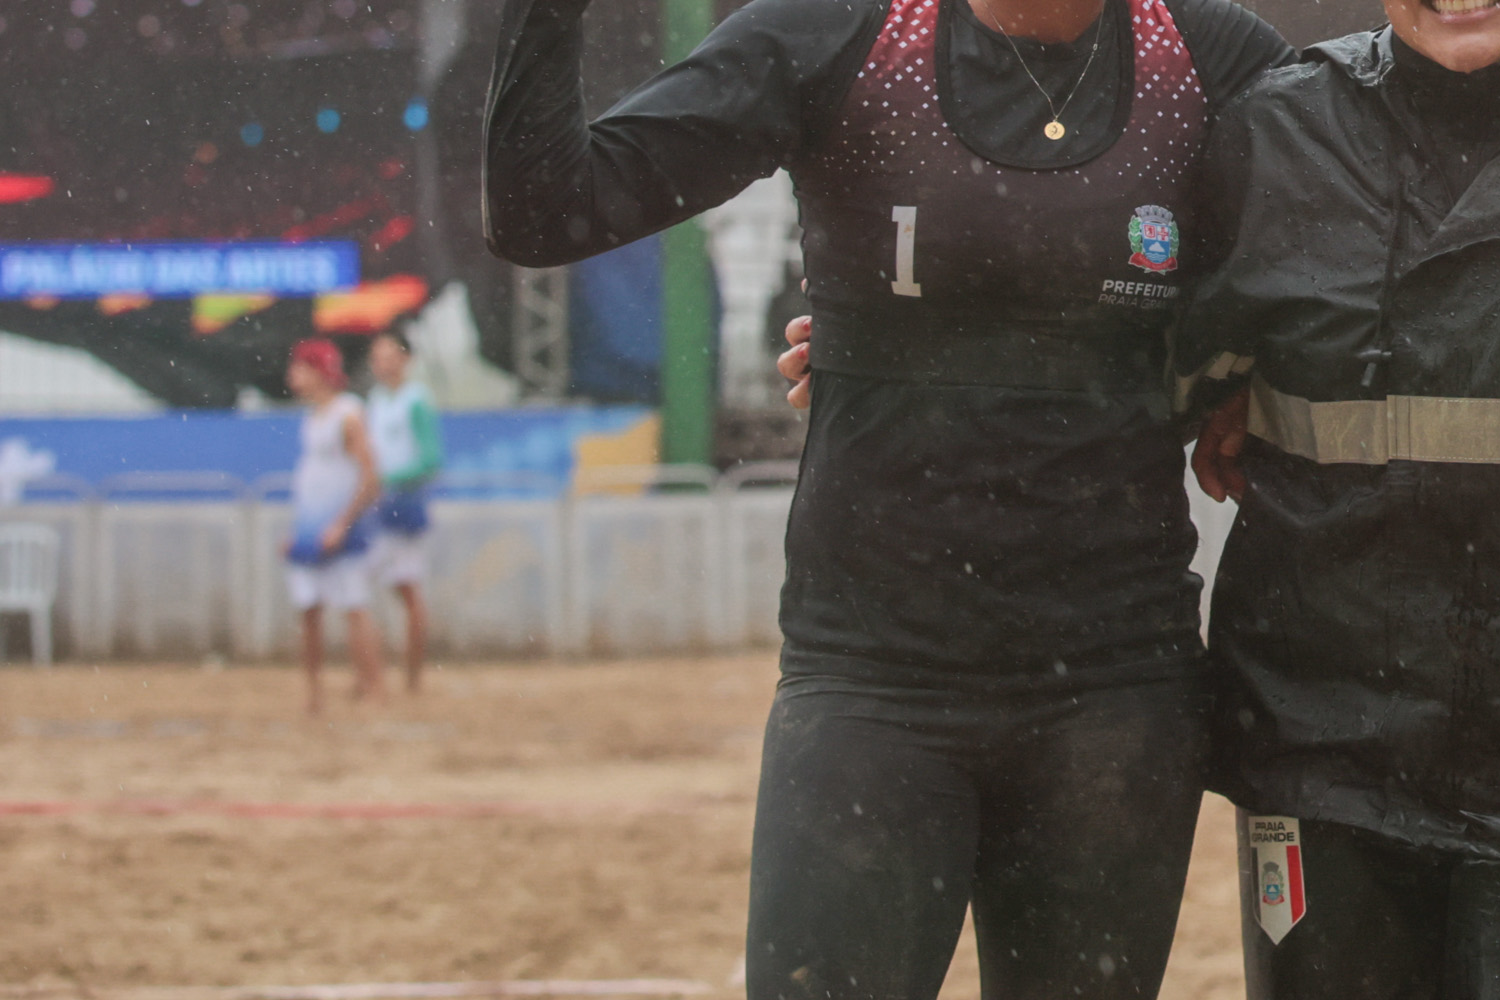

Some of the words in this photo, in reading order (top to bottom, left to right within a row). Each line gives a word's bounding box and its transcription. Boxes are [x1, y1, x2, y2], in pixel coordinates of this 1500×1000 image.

[891, 205, 922, 297] 1
[1255, 821, 1286, 832] PRAIA
[1252, 832, 1295, 842] GRANDE
